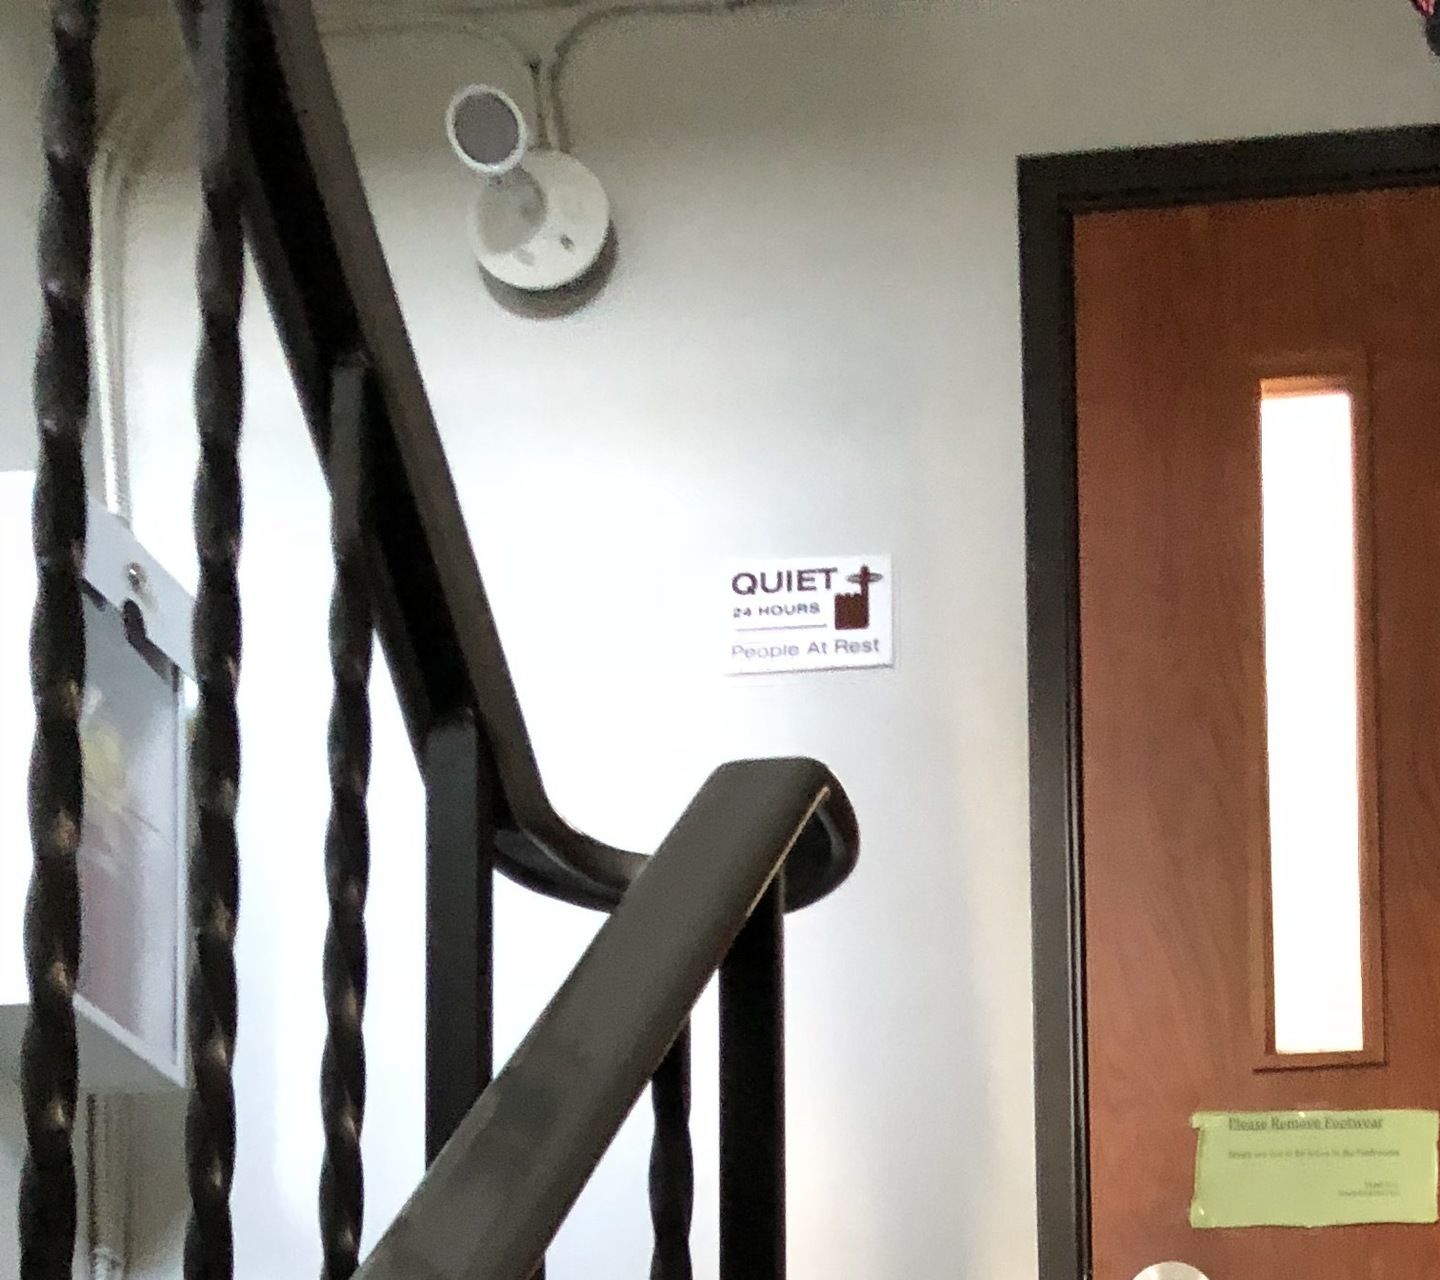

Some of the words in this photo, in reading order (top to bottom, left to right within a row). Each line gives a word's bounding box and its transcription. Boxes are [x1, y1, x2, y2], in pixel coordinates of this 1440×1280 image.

[731, 567, 838, 596] QUIET
[732, 607, 752, 618] 24
[758, 602, 820, 617] HOURS
[731, 644, 800, 659] People
[806, 641, 828, 655] At
[834, 638, 880, 654] Rest
[1228, 1116, 1268, 1131] Please
[1271, 1115, 1321, 1130] Remove
